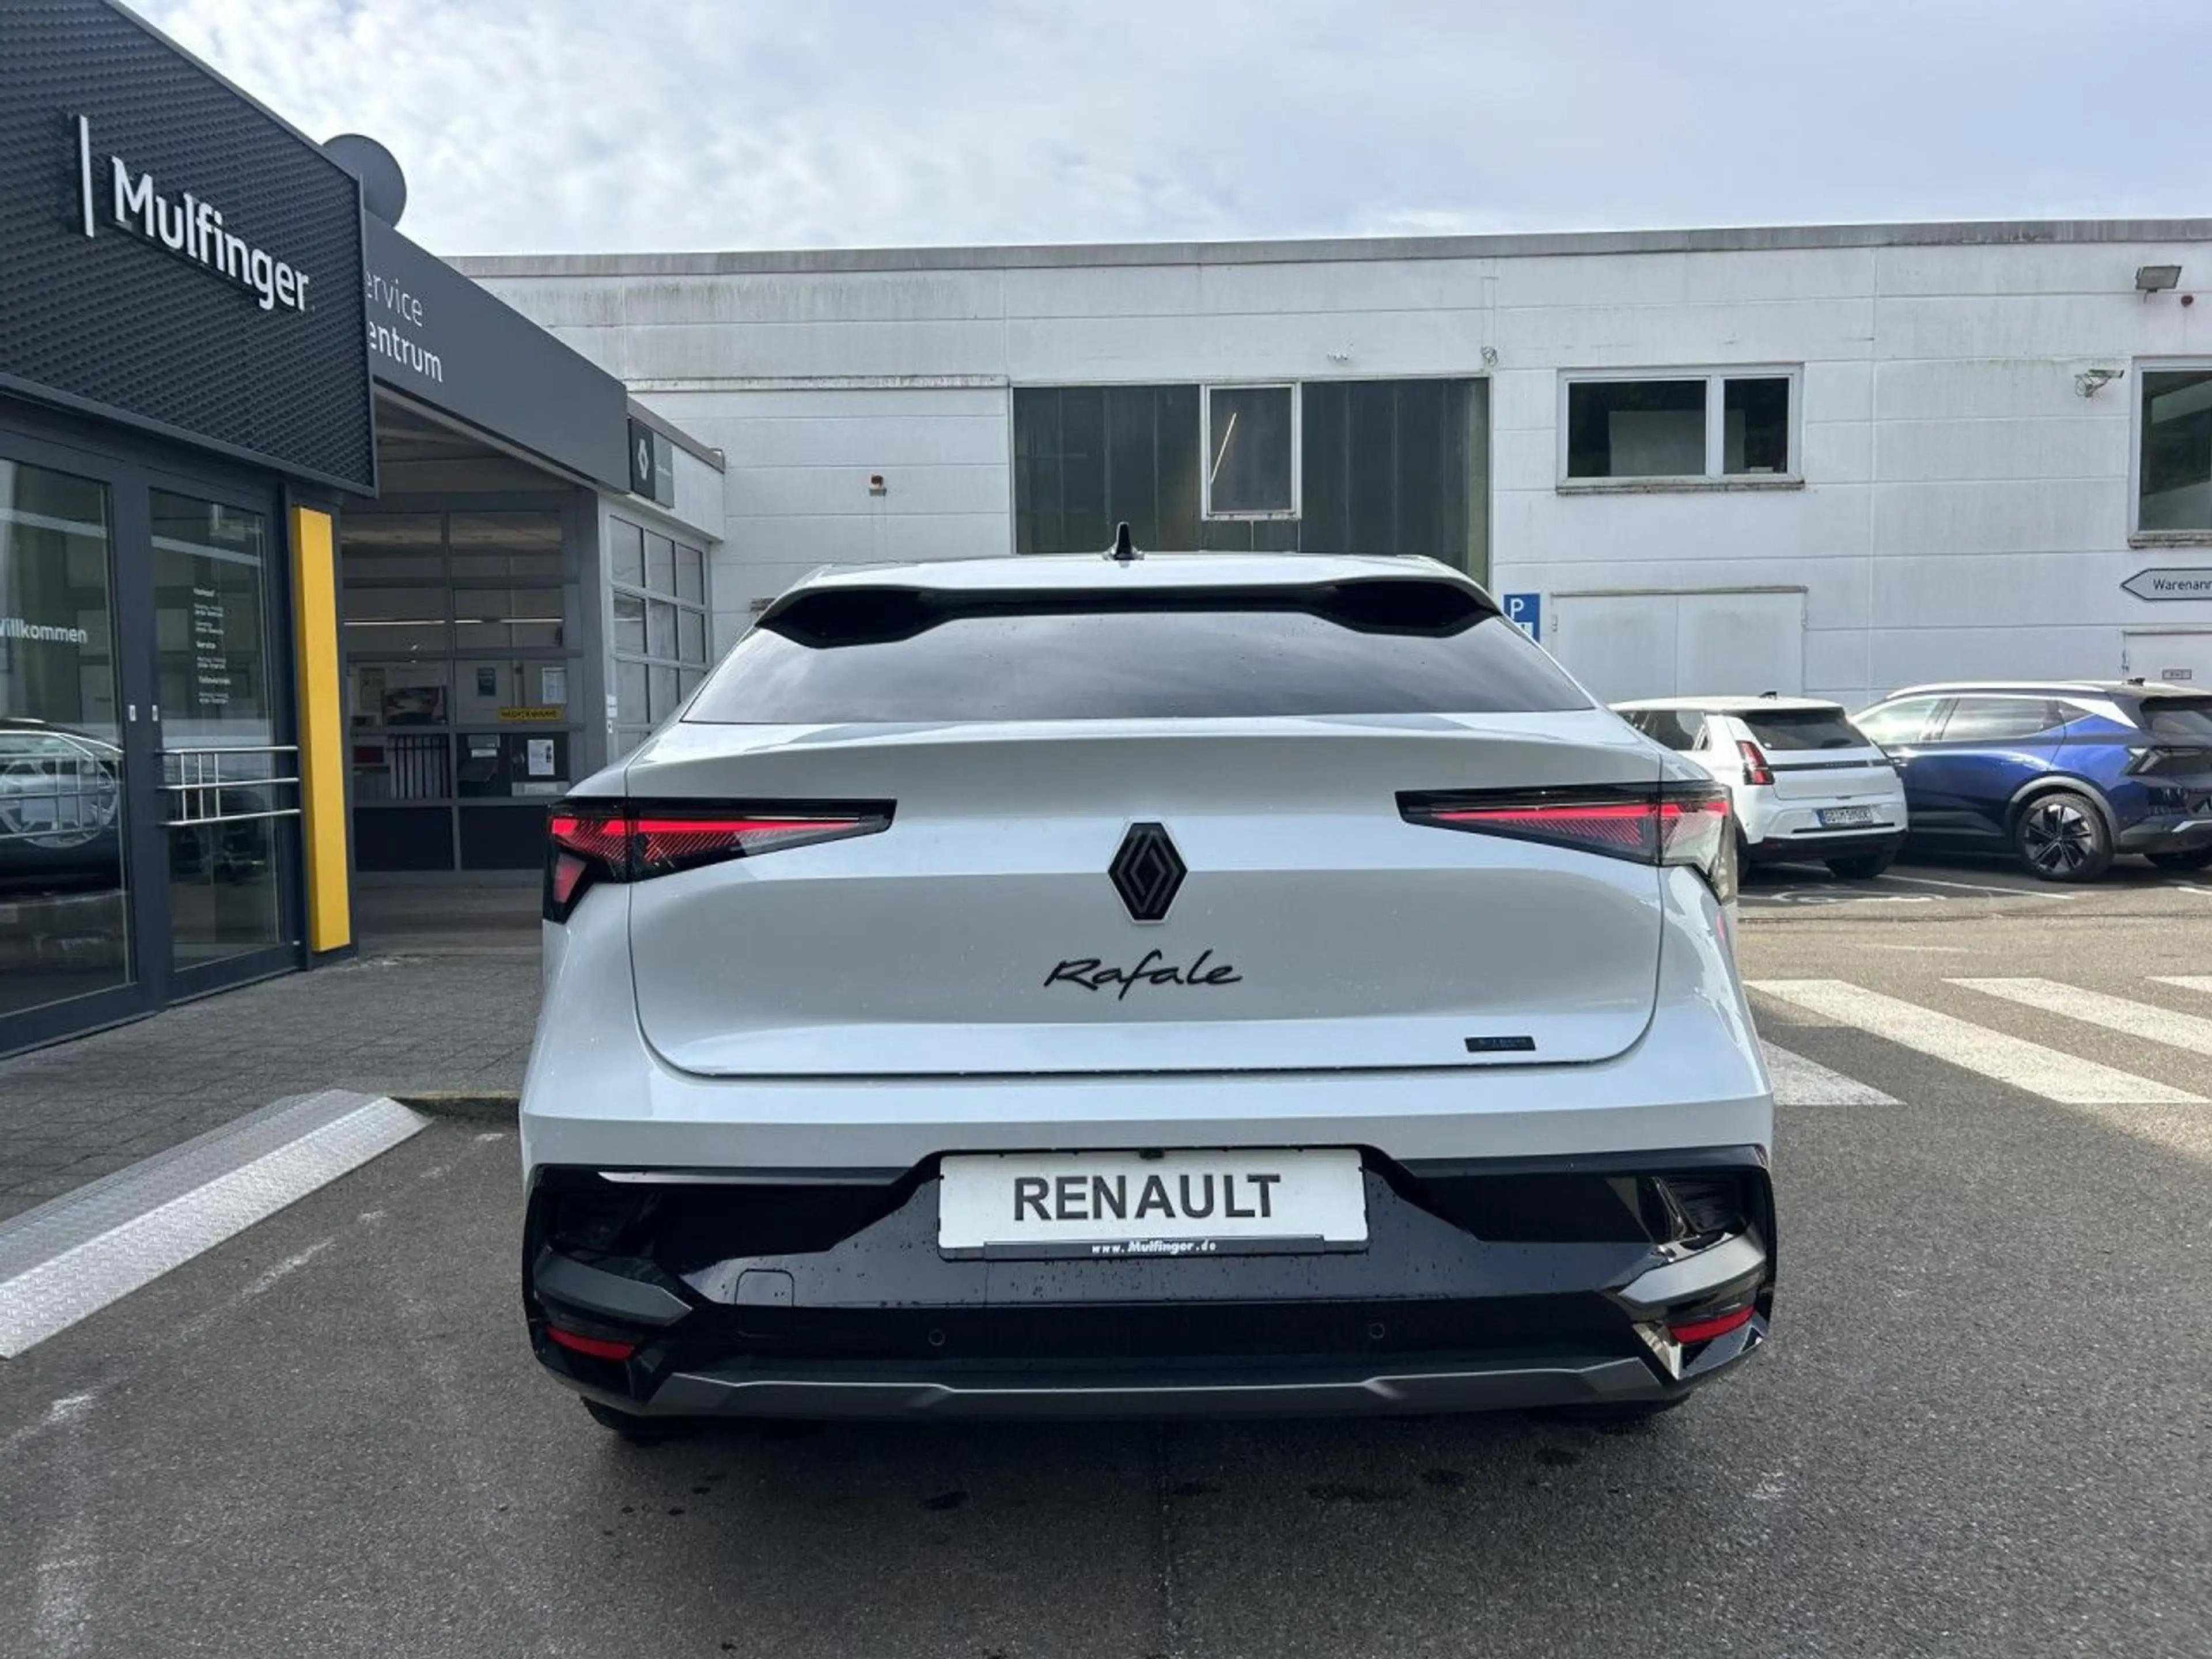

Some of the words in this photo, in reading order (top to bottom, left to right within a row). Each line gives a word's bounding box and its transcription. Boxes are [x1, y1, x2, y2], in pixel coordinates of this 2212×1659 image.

[112, 155, 309, 312] Mulfinger
[366, 271, 423, 327] ervice
[369, 321, 442, 382] entrum
[1510, 598, 1524, 619] P
[1043, 949, 1243, 995] Rafale
[1014, 1174, 1281, 1221] RENAULT
